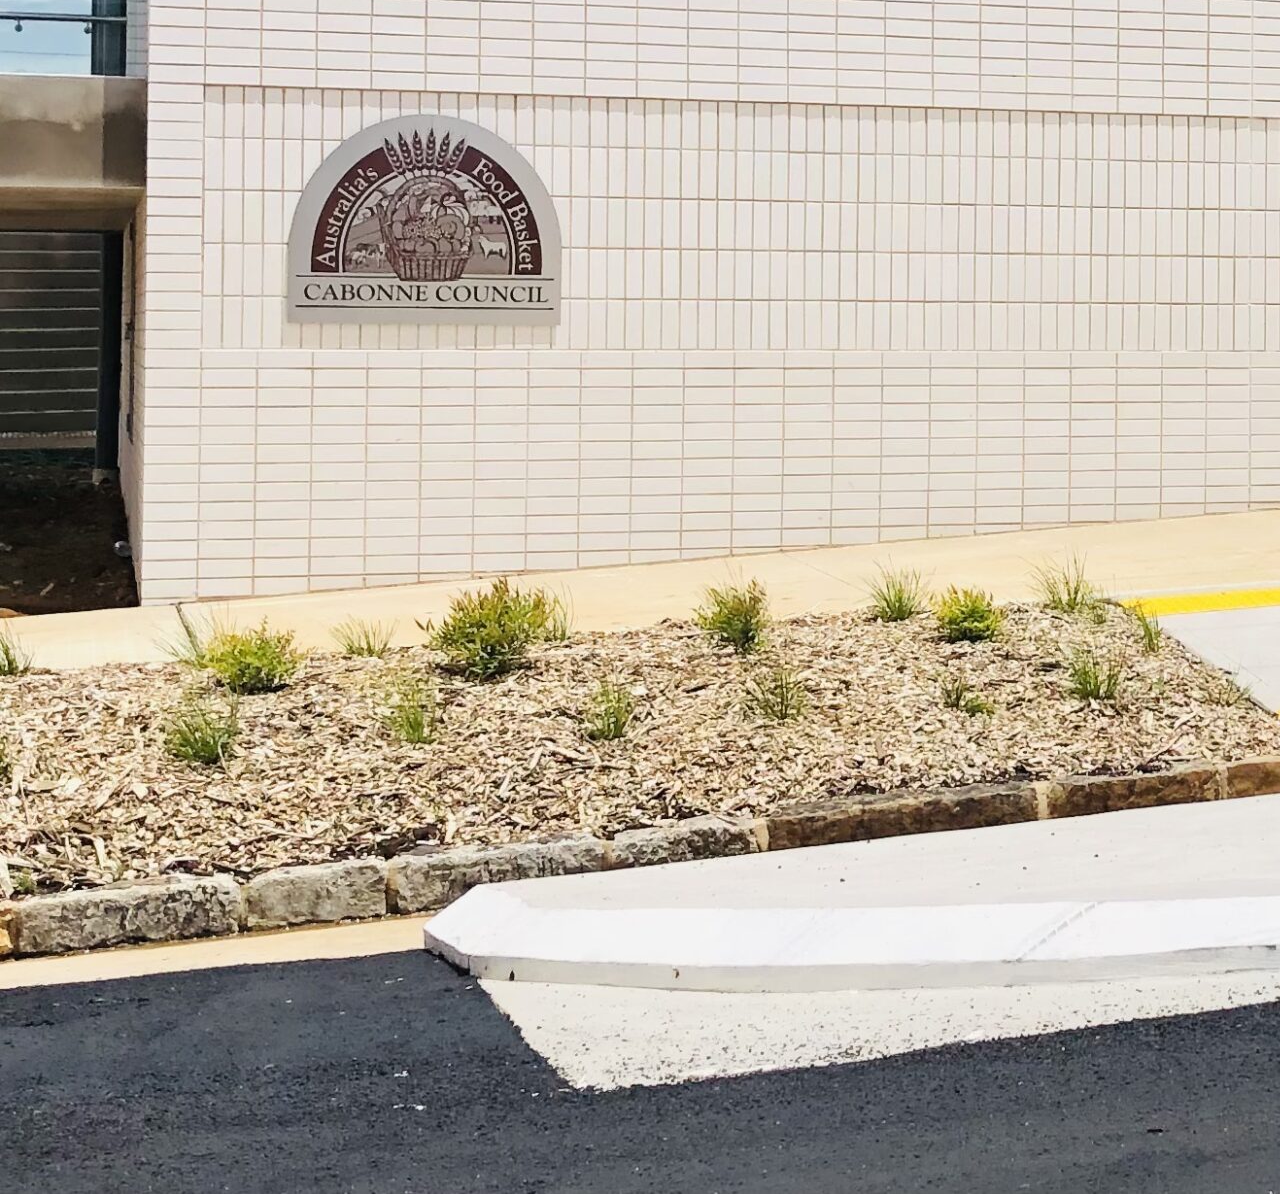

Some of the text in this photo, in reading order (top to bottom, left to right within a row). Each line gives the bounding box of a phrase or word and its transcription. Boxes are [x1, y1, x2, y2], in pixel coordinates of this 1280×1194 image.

[315, 157, 538, 272] Australia's Food Basket
[303, 283, 549, 303] CABONNE COUNCIL
